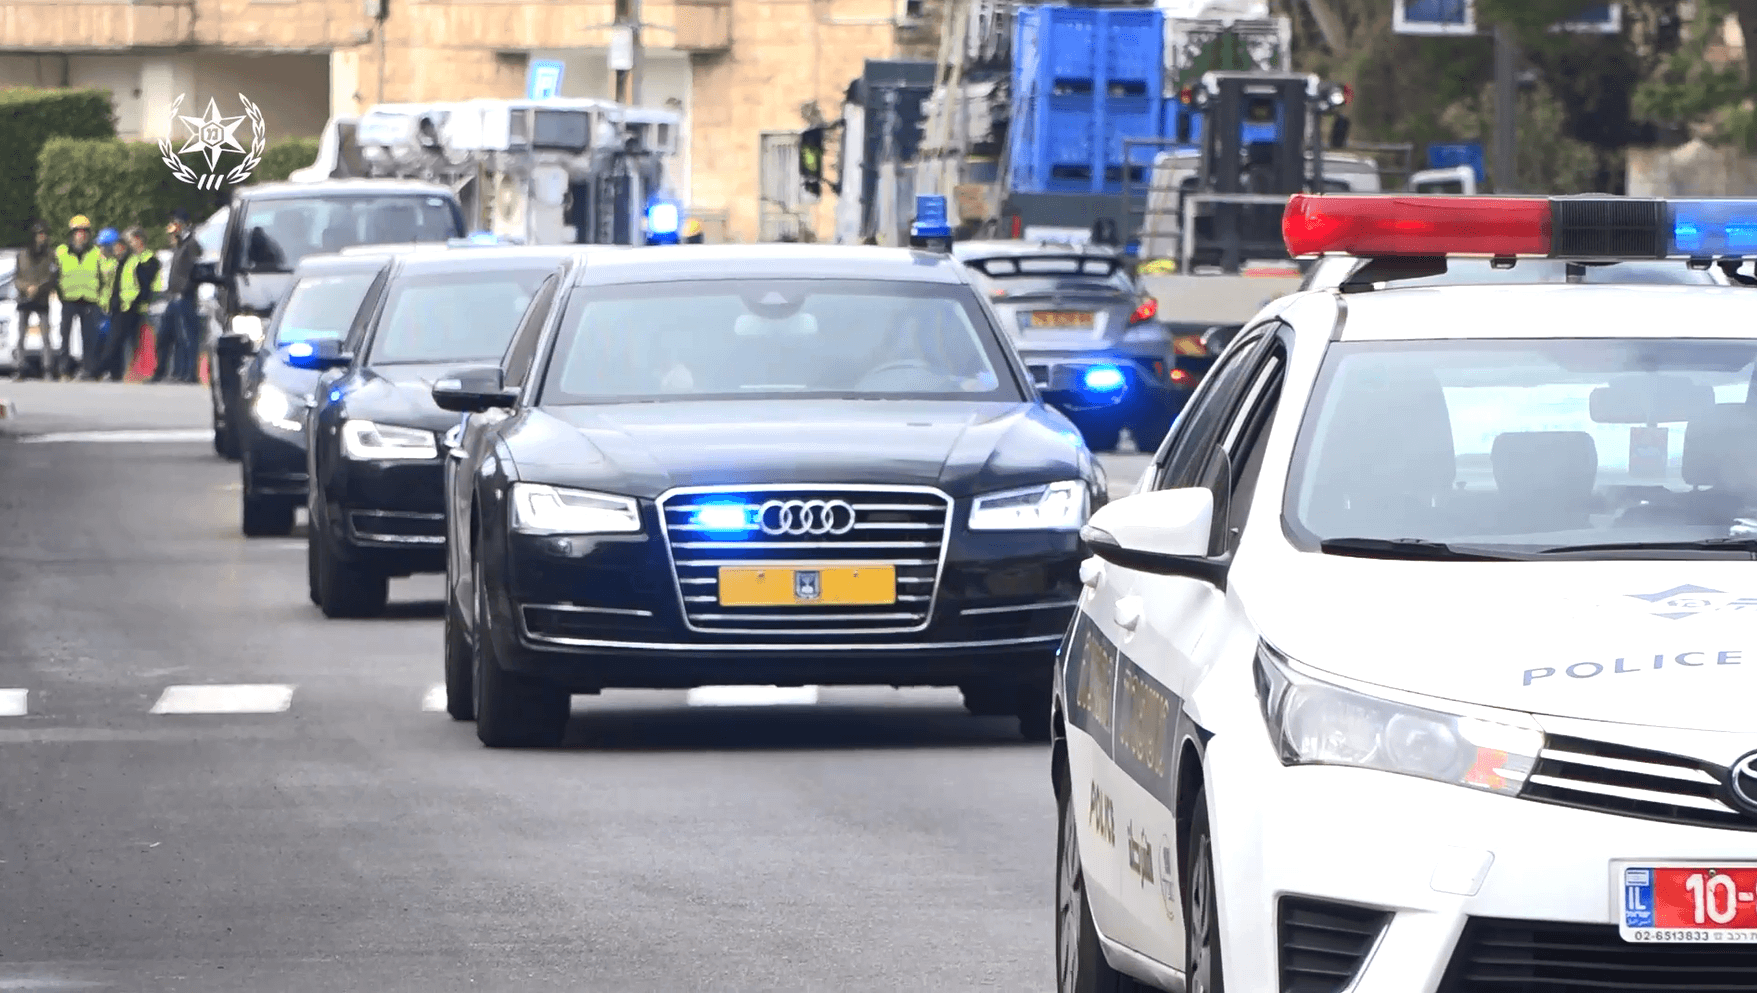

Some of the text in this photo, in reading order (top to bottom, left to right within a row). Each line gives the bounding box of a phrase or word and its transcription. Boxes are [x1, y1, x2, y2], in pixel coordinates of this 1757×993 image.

[1523, 651, 1742, 686] POLICE
[1628, 886, 1647, 910] IL
[1685, 873, 1757, 924] 10-
[1634, 931, 1709, 941] 02-6513833
